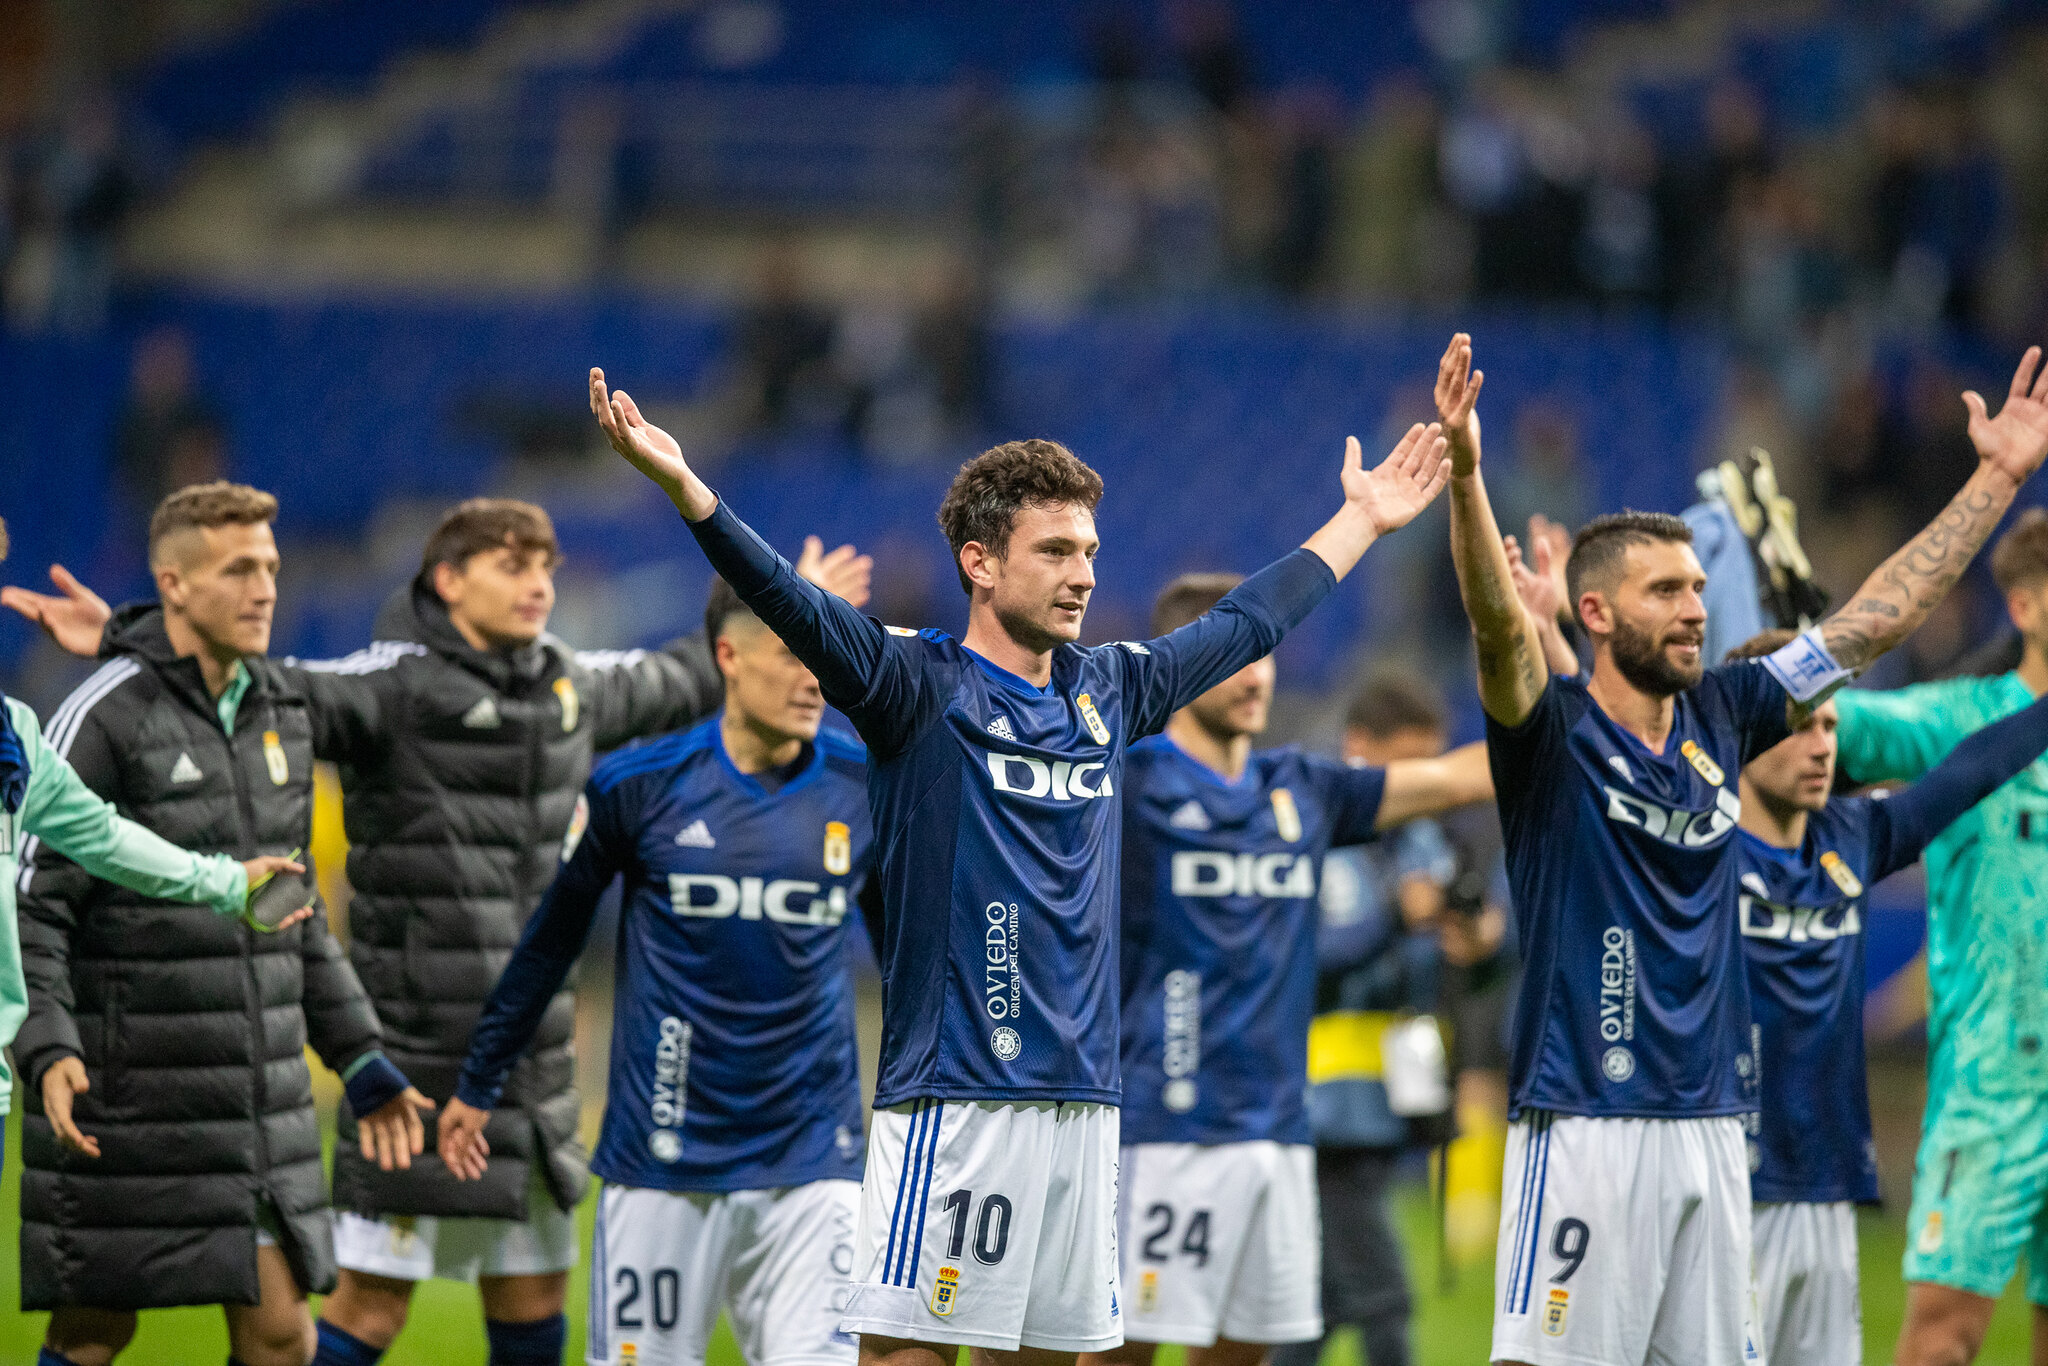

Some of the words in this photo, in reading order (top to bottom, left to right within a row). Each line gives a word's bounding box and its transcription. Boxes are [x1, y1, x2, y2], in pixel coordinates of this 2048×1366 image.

[1171, 851, 1316, 898] DIGI
[985, 901, 1008, 1020] OVIEDO
[1009, 902, 1019, 951] CAMINO
[1009, 951, 1019, 974] DEL
[1600, 925, 1626, 1042] OVIEDO
[1010, 975, 1021, 1019] ORIGEN
[651, 1016, 683, 1127] OVIEDO
[942, 1188, 1013, 1266] 10
[1141, 1201, 1211, 1269] 24
[1548, 1216, 1591, 1285] 9
[615, 1265, 680, 1332] 20
